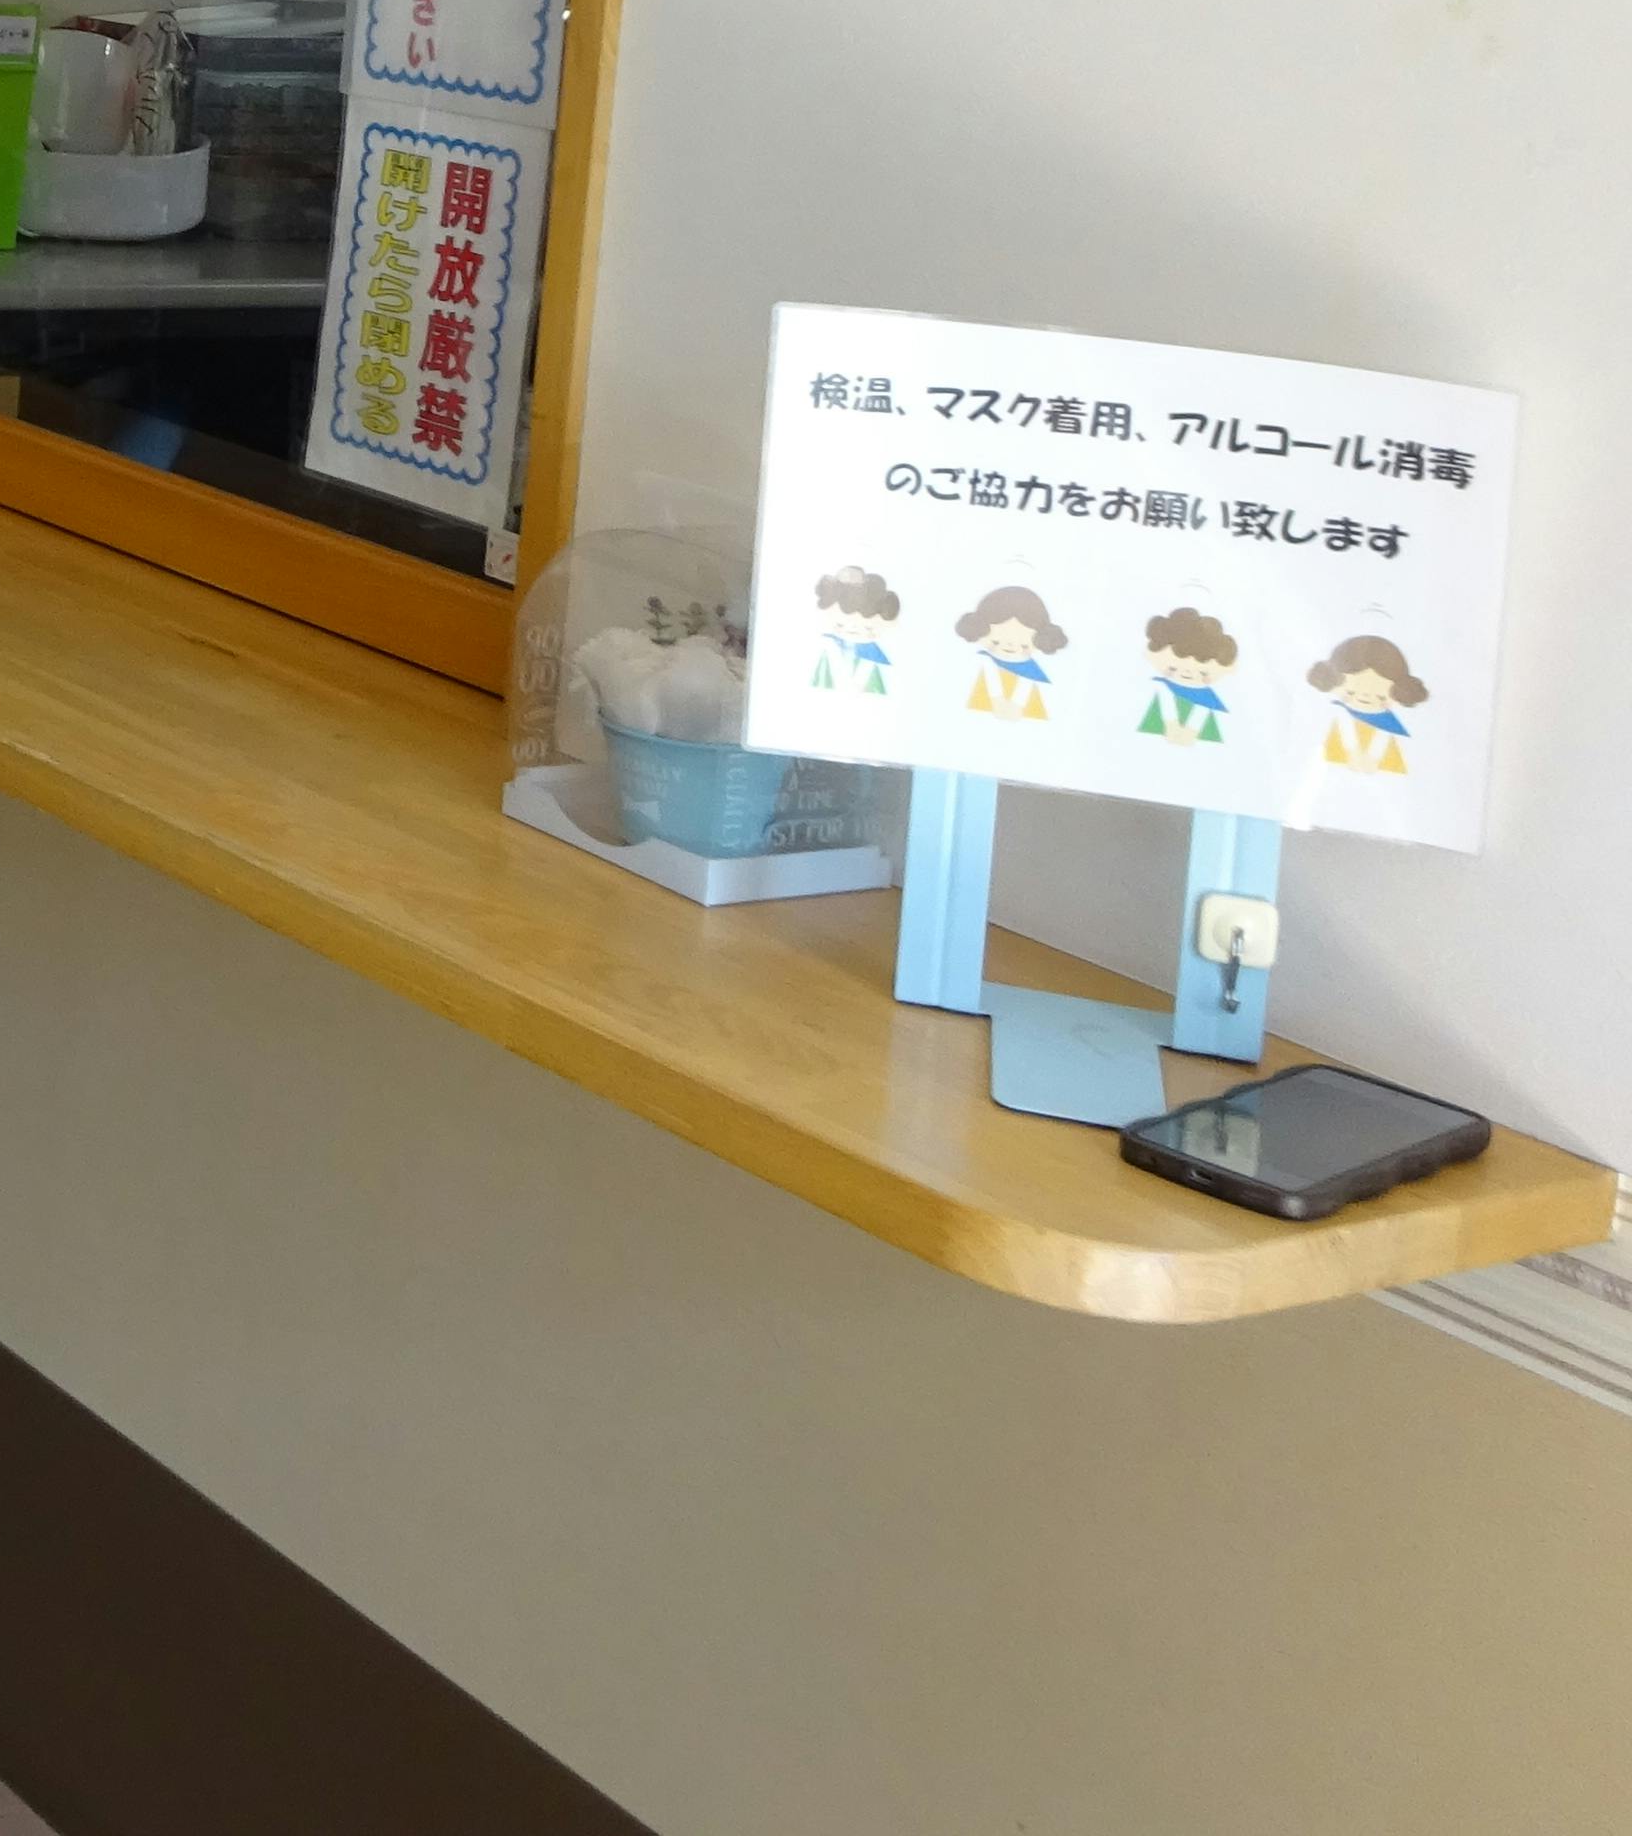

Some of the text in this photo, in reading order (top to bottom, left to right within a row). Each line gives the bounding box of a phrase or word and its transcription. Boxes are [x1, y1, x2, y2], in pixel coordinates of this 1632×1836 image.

[353, 149, 433, 436] 開けたら閉める
[411, 161, 493, 458] 開放厳禁
[810, 371, 1478, 490] 検温、マスク着用、アルコール消毒
[884, 462, 1410, 559] のご協力をお願い致します
